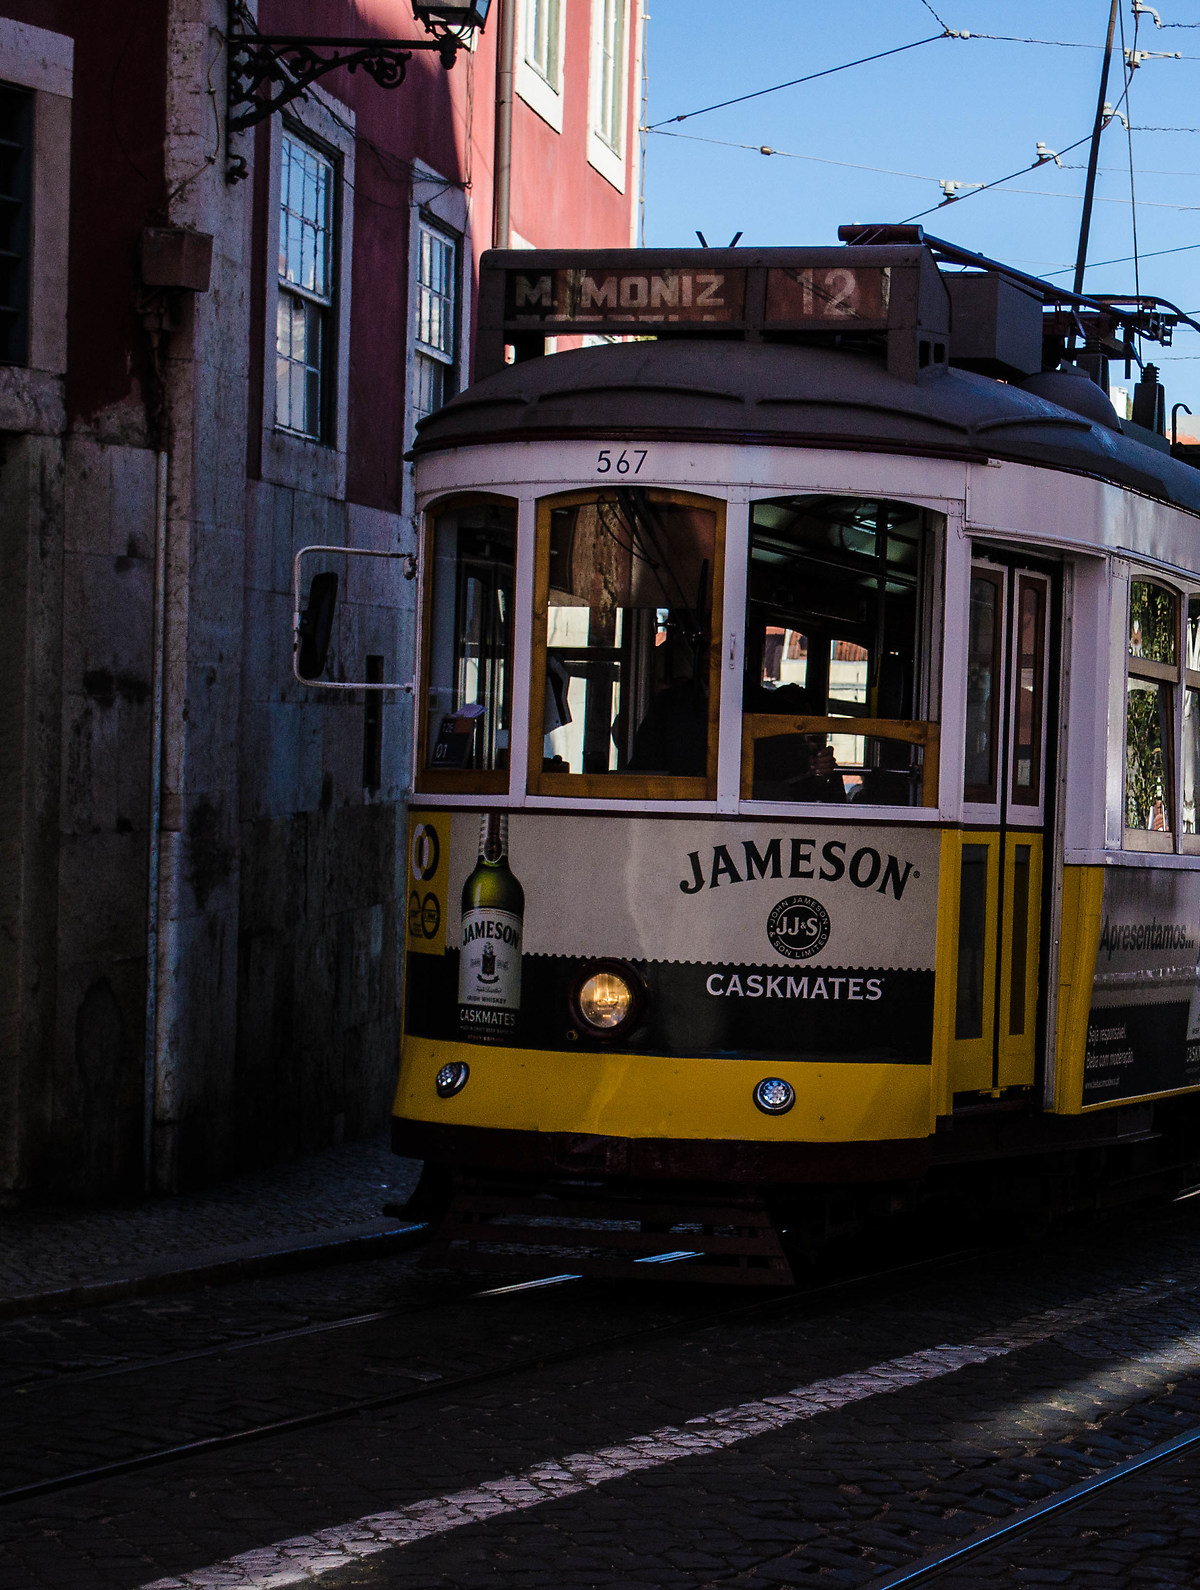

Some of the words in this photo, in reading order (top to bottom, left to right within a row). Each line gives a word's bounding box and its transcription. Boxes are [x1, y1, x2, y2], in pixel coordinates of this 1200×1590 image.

[515, 275, 559, 307] M.
[580, 274, 725, 308] MONIZ
[793, 268, 856, 316] 12
[597, 450, 648, 474] 567
[769, 900, 788, 923] JOHN
[792, 896, 829, 925] JAMESON
[462, 920, 520, 949] JAMESON
[775, 916, 818, 937] JJ&S
[1099, 914, 1194, 961] Apresentamos...
[773, 940, 792, 956] SON
[795, 933, 828, 958] LIMITED
[706, 973, 883, 1001] CASKMATES
[460, 1008, 516, 1026] CASKMATES
[1099, 1052, 1110, 1067] com
